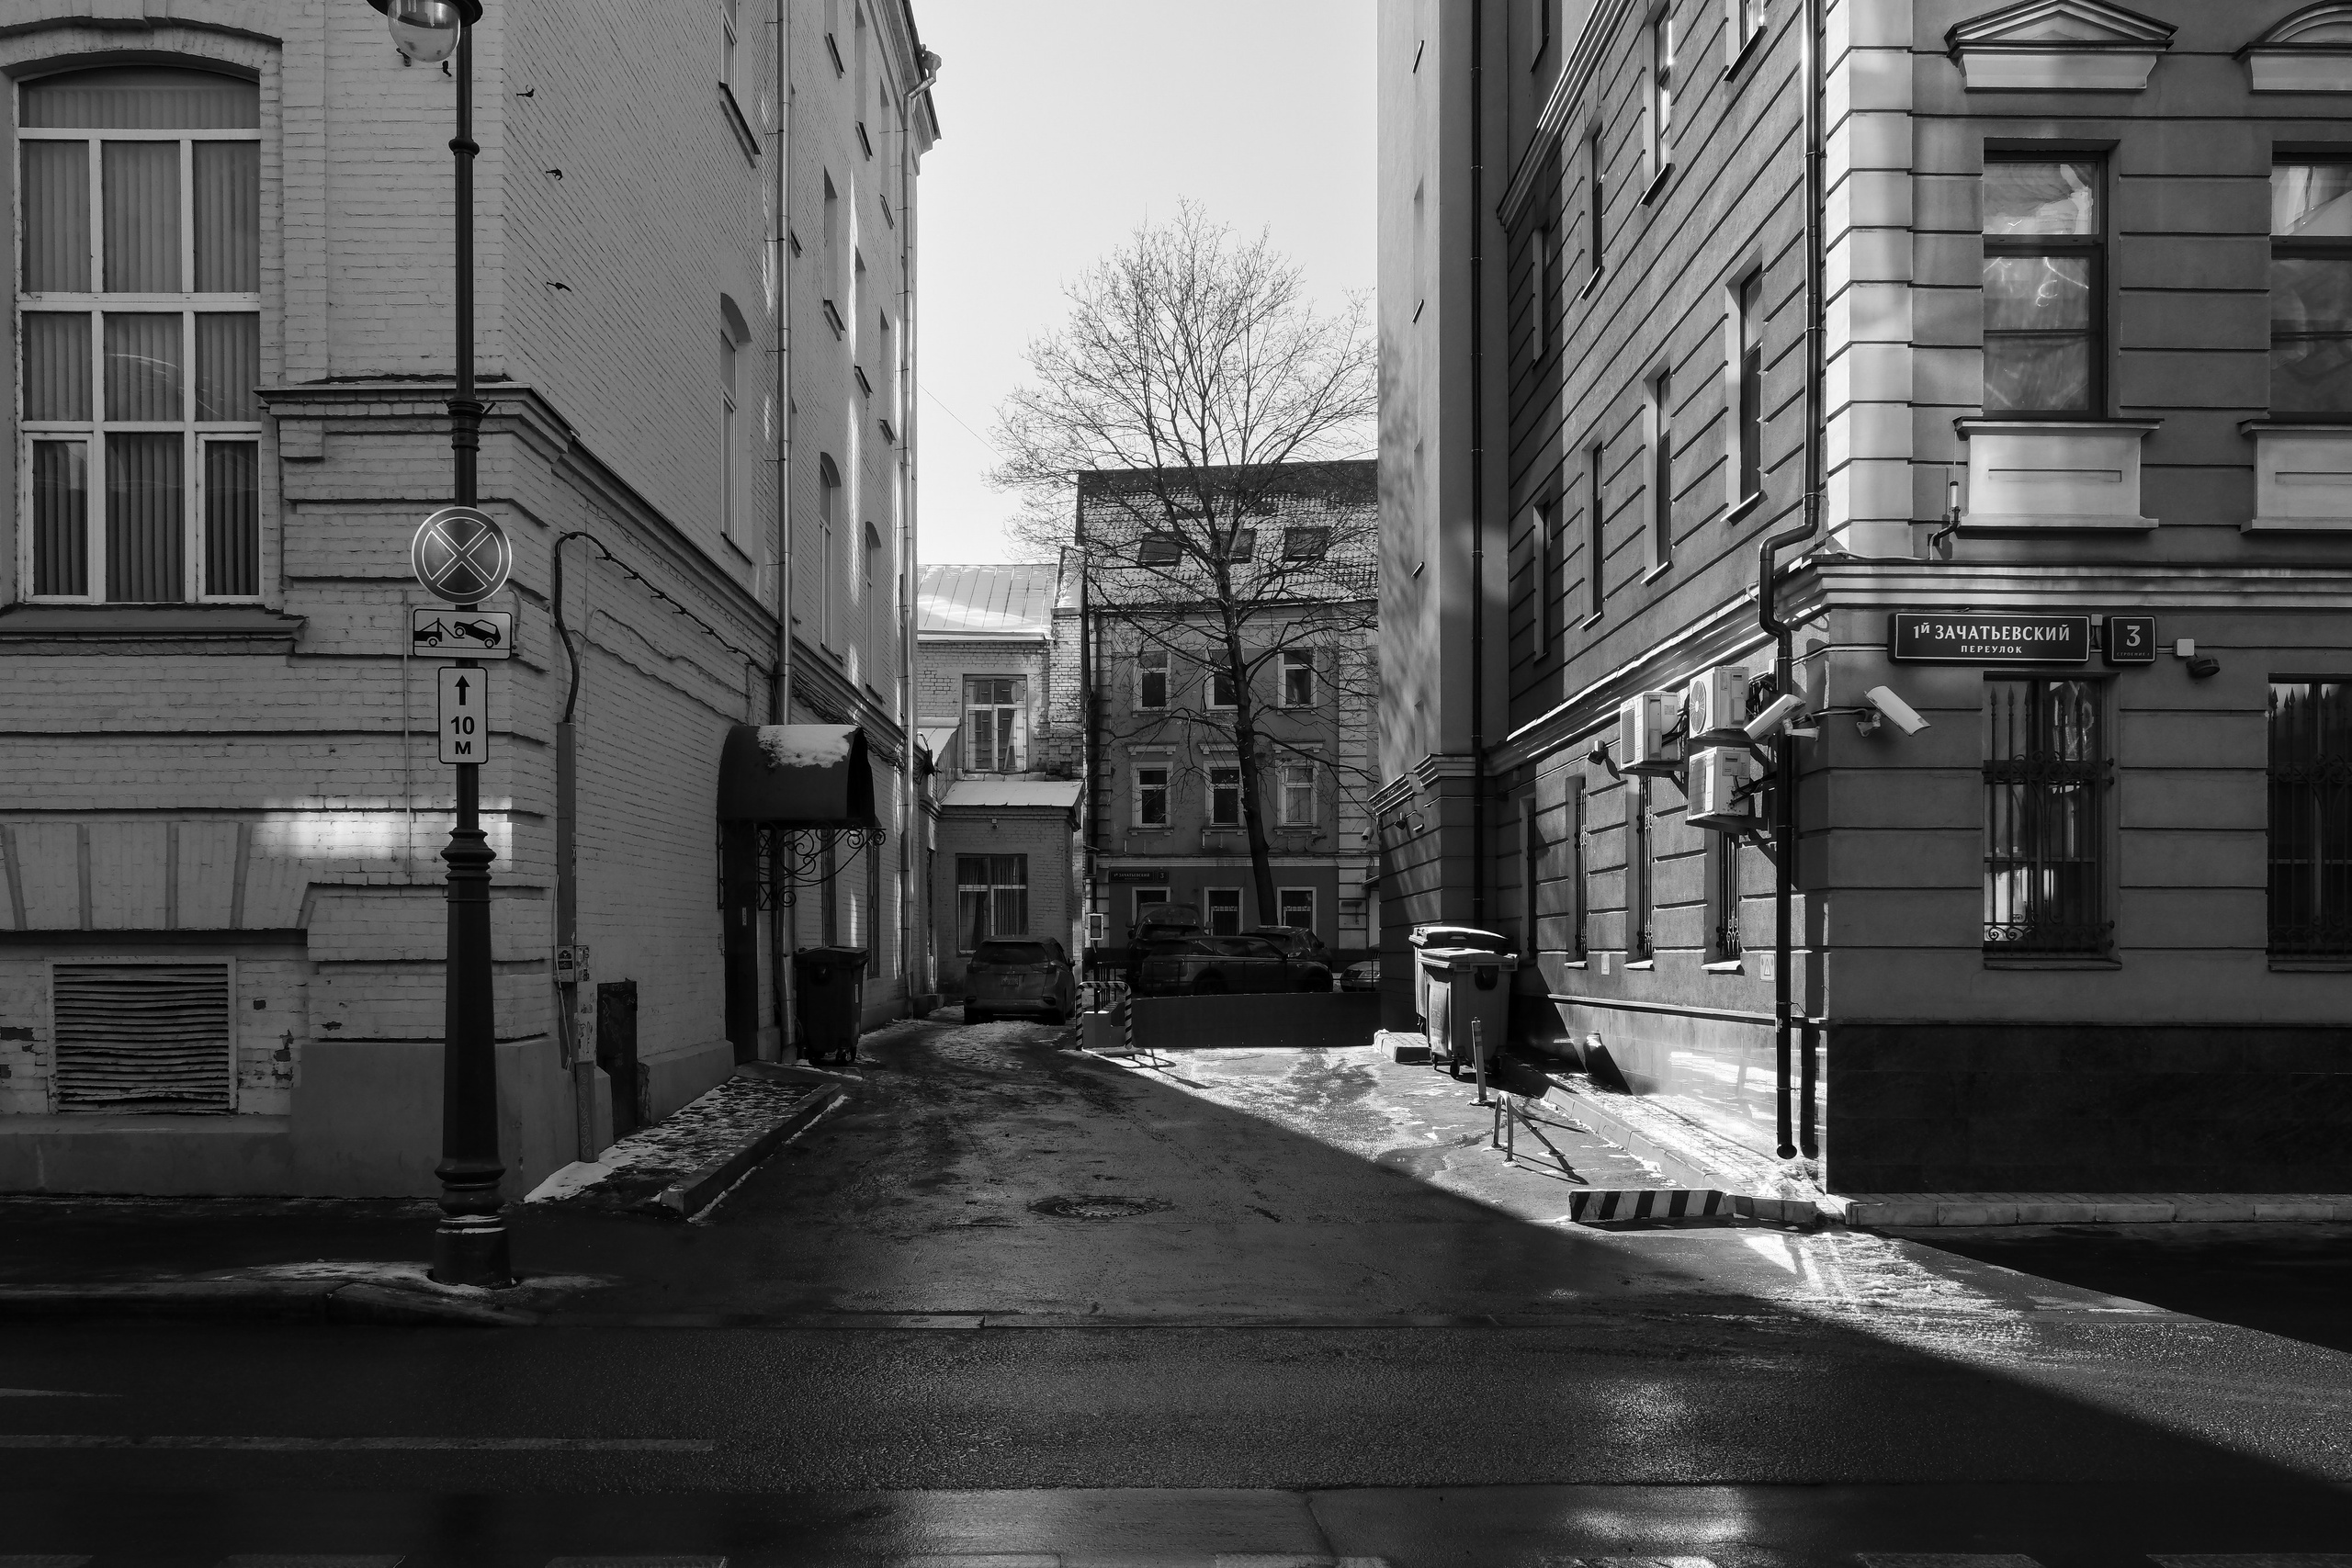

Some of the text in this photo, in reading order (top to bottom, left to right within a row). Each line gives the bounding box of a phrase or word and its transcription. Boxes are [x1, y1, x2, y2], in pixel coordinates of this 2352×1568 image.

[1934, 624, 2070, 641] ЗАЧАТЬЕВСКИЙ
[2126, 625, 2141, 647] 3
[1961, 645, 2023, 654] ПЕРЕУЛОК
[450, 716, 475, 735] 10
